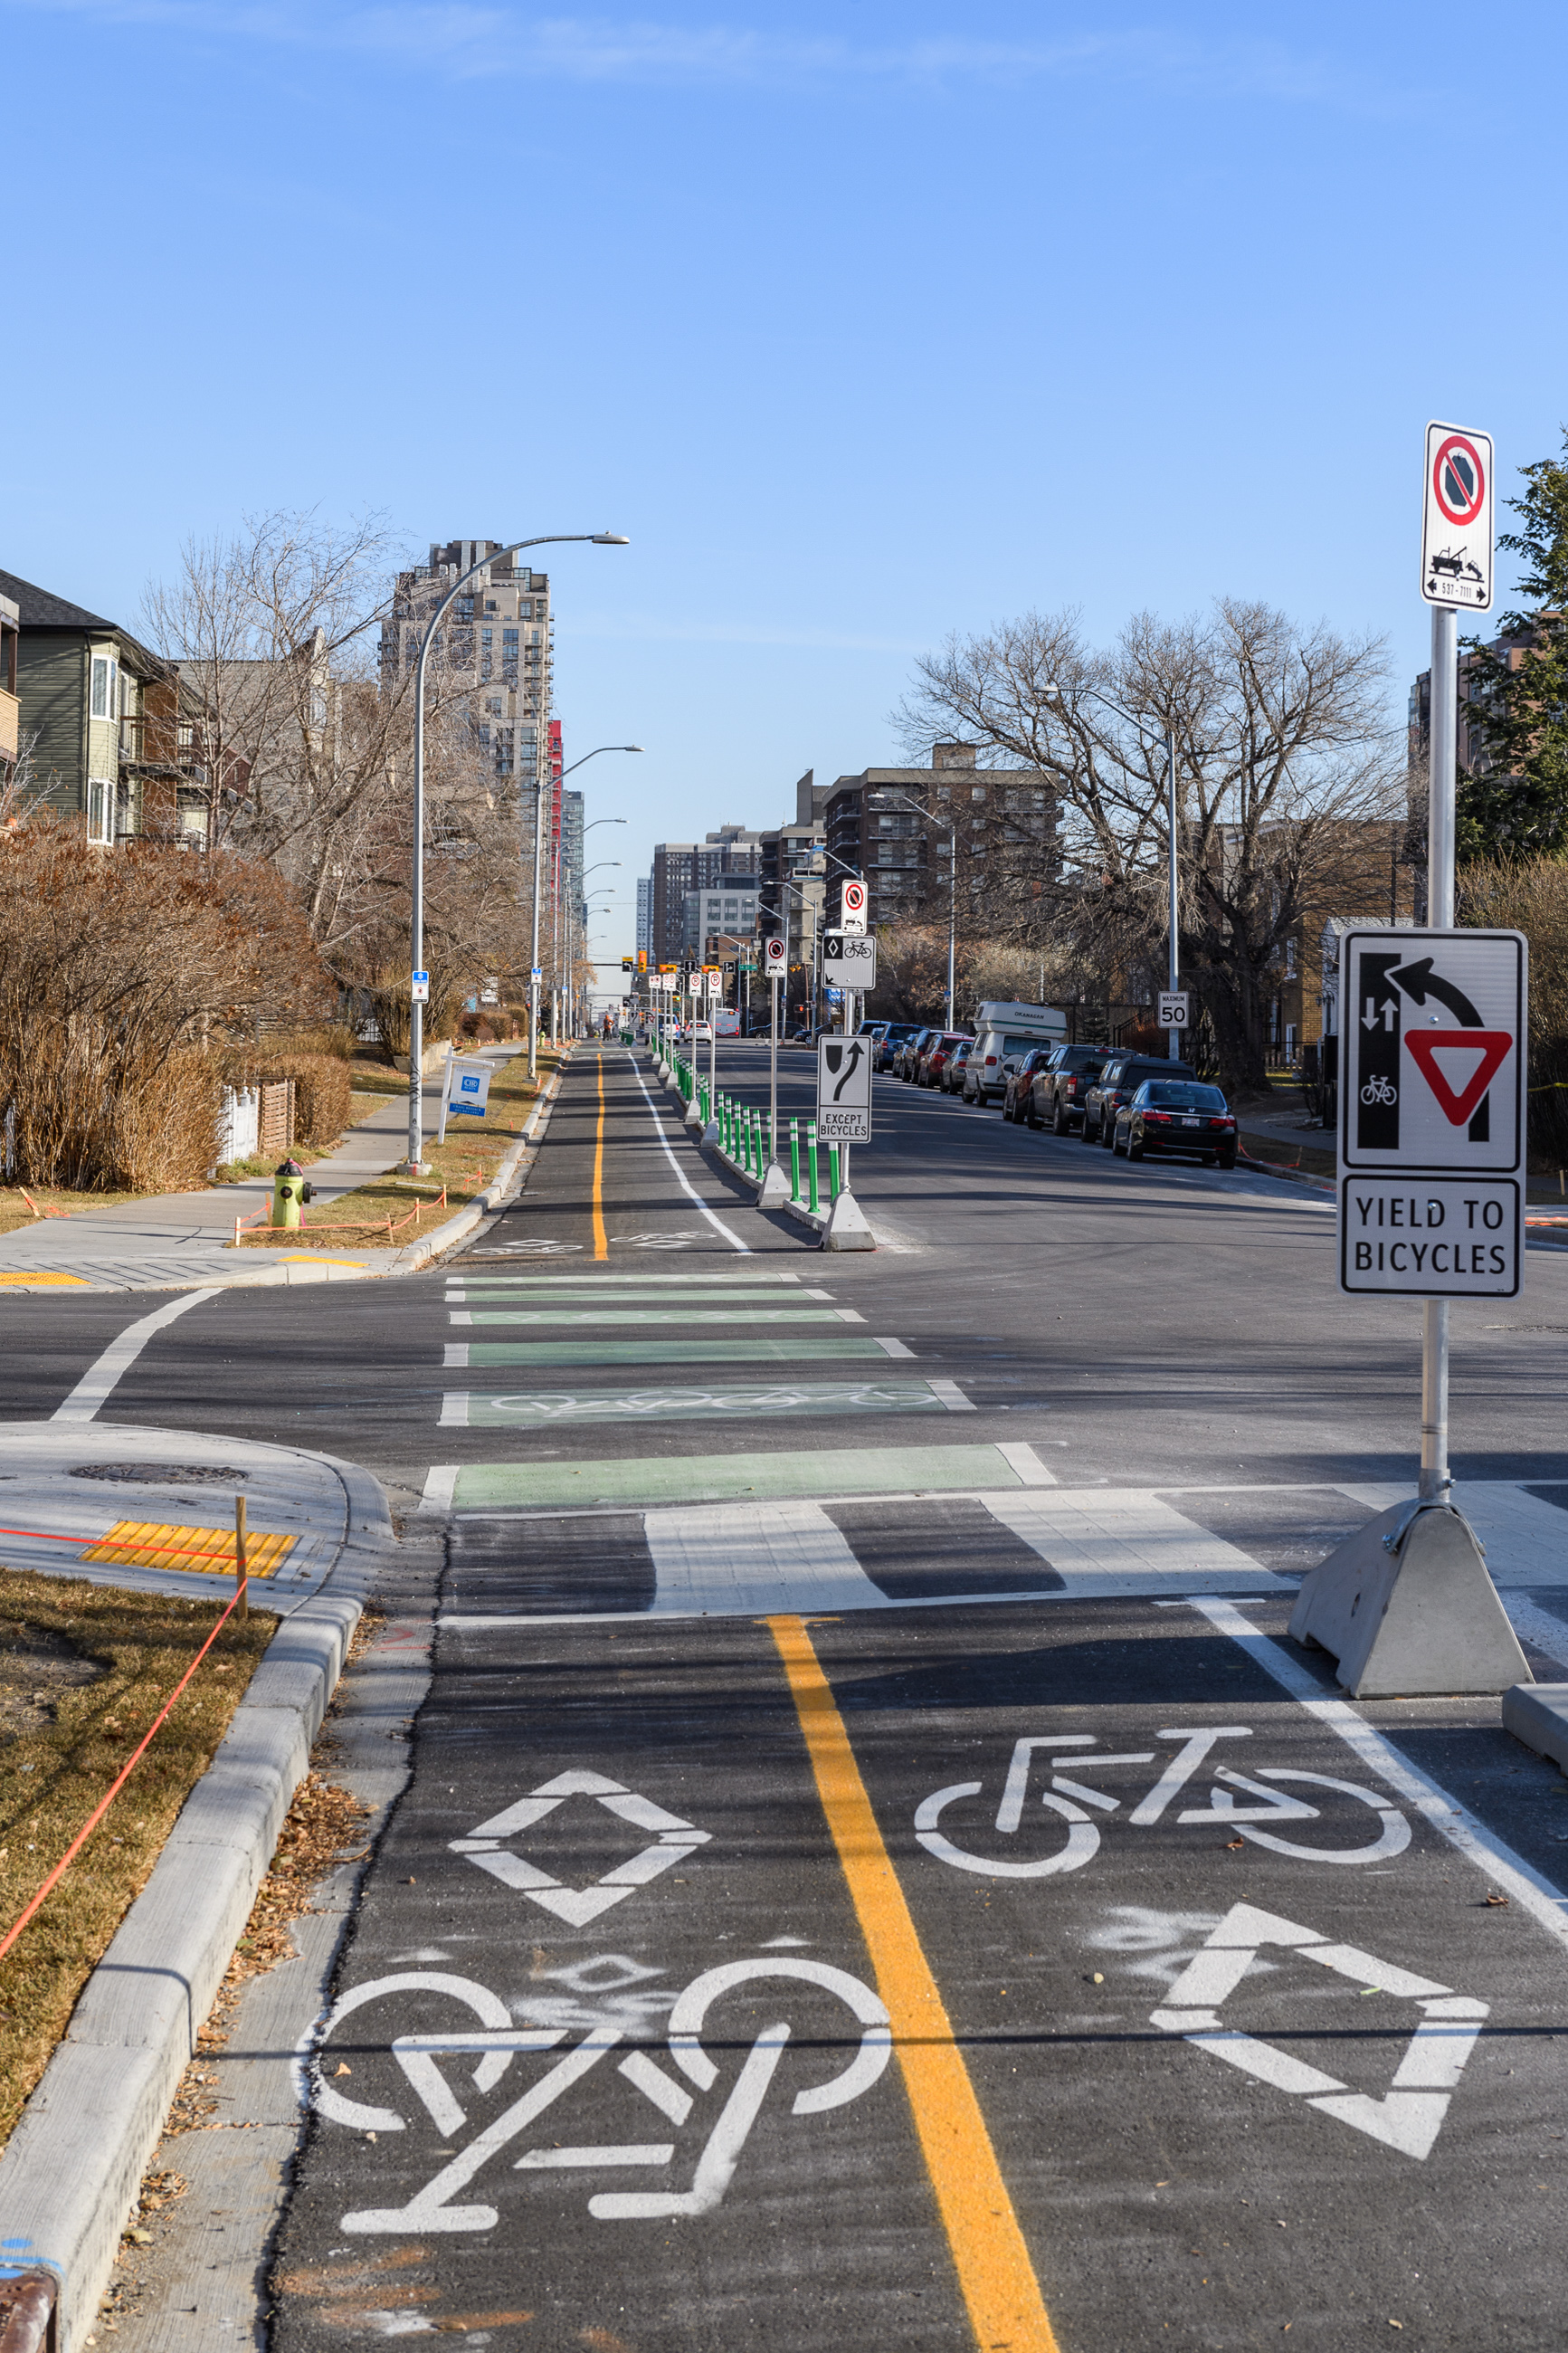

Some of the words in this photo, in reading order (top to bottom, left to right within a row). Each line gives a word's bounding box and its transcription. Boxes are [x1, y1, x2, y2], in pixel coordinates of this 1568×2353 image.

[1442, 583, 1471, 598] 537-7111
[1014, 1011, 1045, 1020] OKANAGAN
[1162, 1006, 1185, 1023] 50
[463, 1079, 478, 1087] CIR
[826, 1114, 861, 1124] EXCEPT
[821, 1125, 866, 1136] BICYCLES
[1355, 1197, 1445, 1228] YIELD
[1463, 1200, 1503, 1230] TO
[1355, 1241, 1506, 1274] BICYCLES
